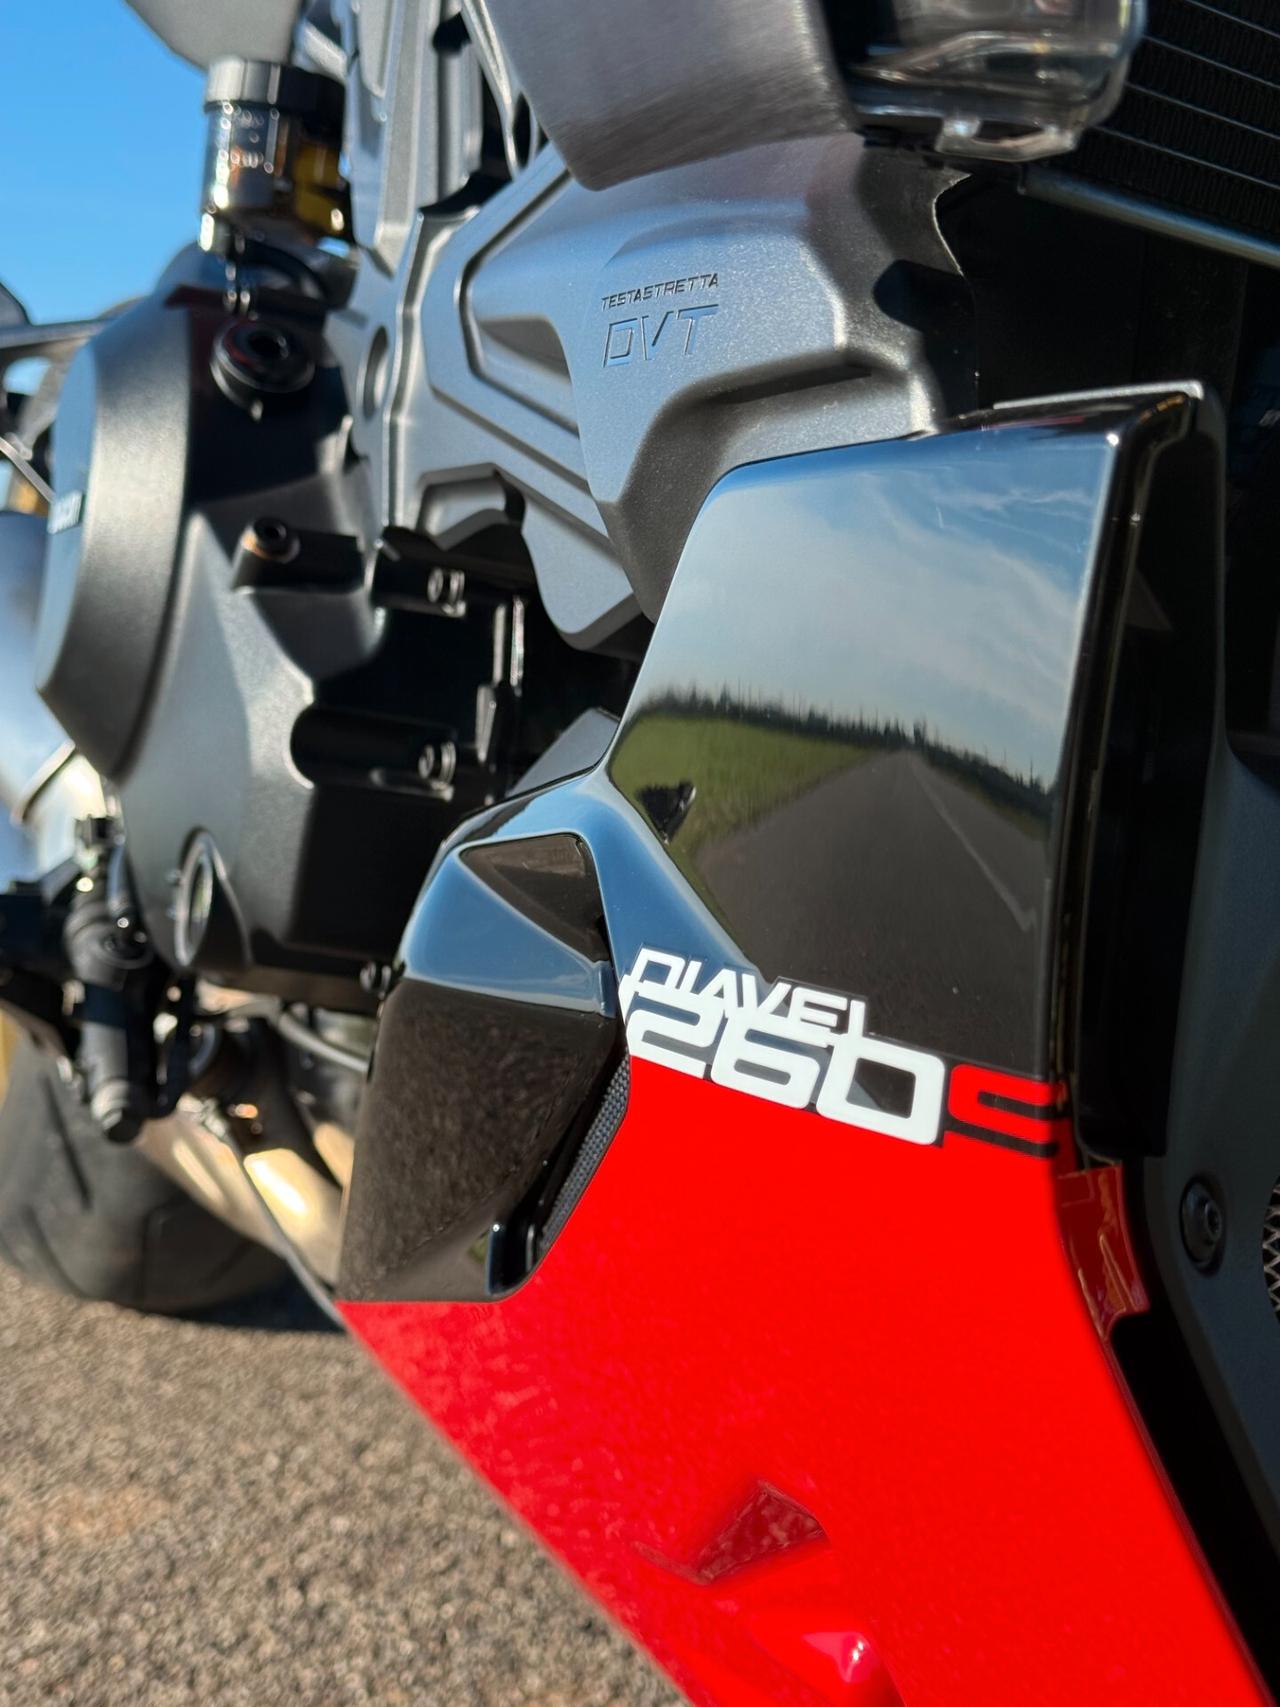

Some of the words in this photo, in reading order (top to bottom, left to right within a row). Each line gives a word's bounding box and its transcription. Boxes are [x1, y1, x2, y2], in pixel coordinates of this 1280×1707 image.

[601, 272, 719, 311] TESTASTRETTA
[602, 303, 720, 368] DVT
[628, 947, 868, 1043] DIAVEL
